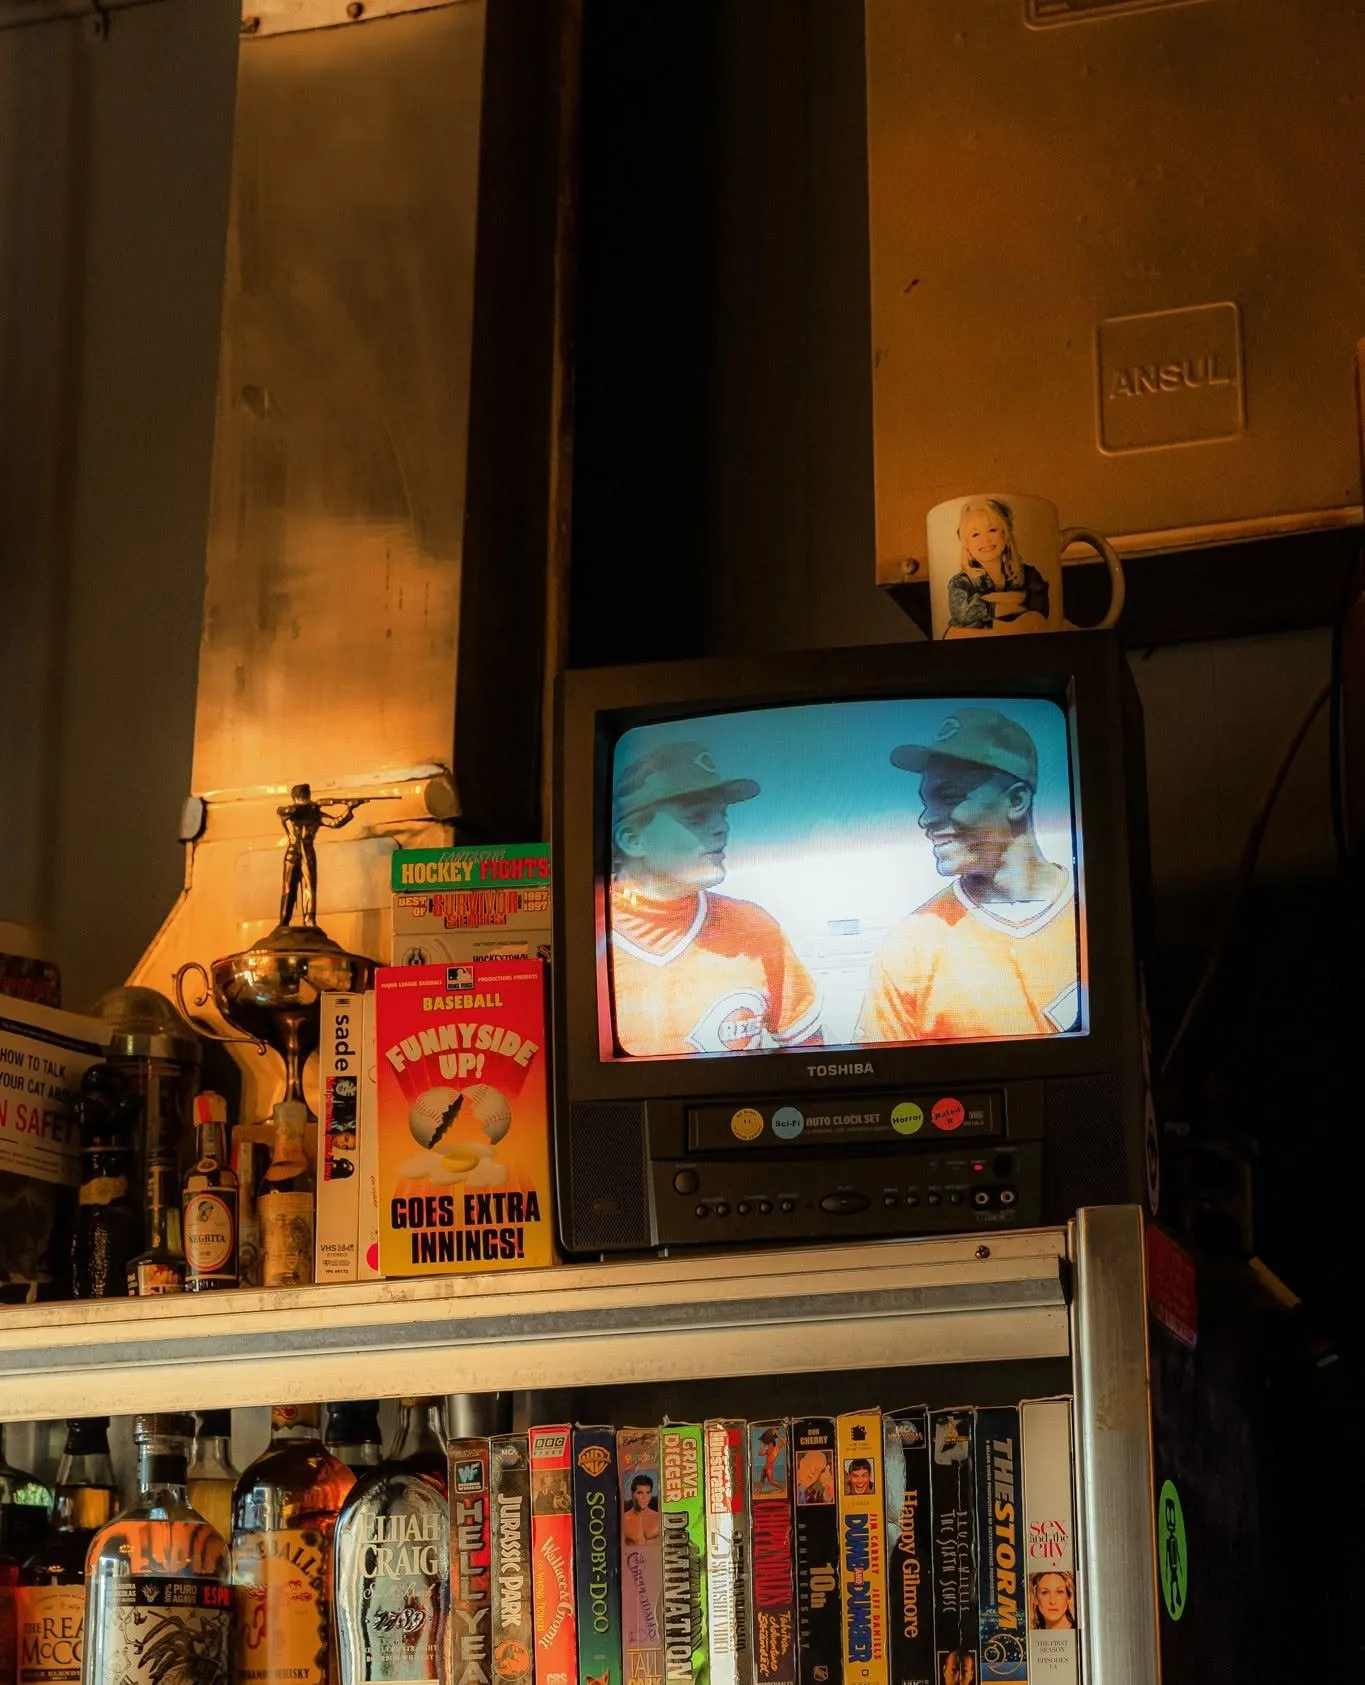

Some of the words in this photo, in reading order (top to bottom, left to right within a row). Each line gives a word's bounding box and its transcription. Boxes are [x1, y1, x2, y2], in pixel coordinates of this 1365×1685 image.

[1108, 354, 1231, 399] ANSUL
[401, 861, 473, 884] HOCKEY
[480, 857, 550, 881] FIGHTS
[398, 896, 427, 907] BEST
[412, 907, 427, 917] OF
[432, 891, 518, 917] SURVIVOR
[523, 901, 548, 912] 1997
[419, 979, 443, 987] BASEBALL
[423, 993, 503, 1011] BASEBALL
[335, 1013, 356, 1072] sade
[385, 1023, 540, 1073] FUNNYSIDE
[0, 1048, 25, 1067] HOW
[28, 1055, 40, 1072] TO
[43, 1059, 66, 1079] TALK
[438, 1052, 485, 1080] UP!
[807, 1062, 875, 1078] TOSHIBA
[28, 1079, 46, 1096] CAT
[775, 1119, 801, 1128] Sci-Fi
[806, 1116, 831, 1128] AUTO
[833, 1115, 862, 1126] CLOCK
[864, 1113, 881, 1124] SET
[892, 1114, 922, 1125] Horror
[934, 1106, 961, 1120] Rated
[391, 1197, 455, 1229] GOES
[463, 1191, 541, 1226] EXTRA
[188, 1233, 226, 1243] NEGRITA
[320, 1244, 337, 1252] VHS
[411, 1227, 525, 1265] INNINGS!
[535, 1437, 565, 1448] BBC
[800, 1436, 828, 1446] CHERRY
[664, 1433, 682, 1505] DIGGER
[682, 1438, 698, 1498] GRAVE
[993, 1437, 1014, 1503] THE
[360, 1512, 440, 1545] ELIJAH
[498, 1493, 523, 1576] JURASSIC
[869, 1513, 878, 1530] JIM
[898, 1489, 918, 1555] Happy
[1029, 1532, 1048, 1543] and
[1053, 1531, 1069, 1543] the
[1030, 1520, 1067, 1537] sex
[456, 1500, 485, 1600] HELL
[845, 1513, 870, 1573] DUMB
[870, 1535, 880, 1575] CARREY
[935, 1539, 957, 1572] SIXTH
[1030, 1539, 1068, 1567] city
[361, 1544, 440, 1580] CRAIG
[540, 1535, 568, 1590] Wallace
[586, 1491, 610, 1634] SCOOBY-DOO
[994, 1501, 1018, 1630] STORM
[173, 1584, 197, 1595] PURO
[173, 1595, 197, 1603] AGAVE
[559, 1590, 571, 1601] &
[662, 1512, 694, 1681] DOMINATION
[711, 1561, 728, 1619] SWIMSUIT
[809, 1562, 836, 1609] 10th
[872, 1588, 881, 1610] JEFF
[902, 1558, 921, 1638] Gilmore
[959, 1566, 970, 1612] WILLIS
[498, 1575, 524, 1629] PARK
[42, 1615, 84, 1639] REA
[538, 1601, 574, 1650] Gromit
[713, 1621, 729, 1654] VIDEO
[846, 1580, 872, 1663] DUMBER
[872, 1614, 882, 1660] DANIELS
[627, 1648, 662, 1680] TALL
